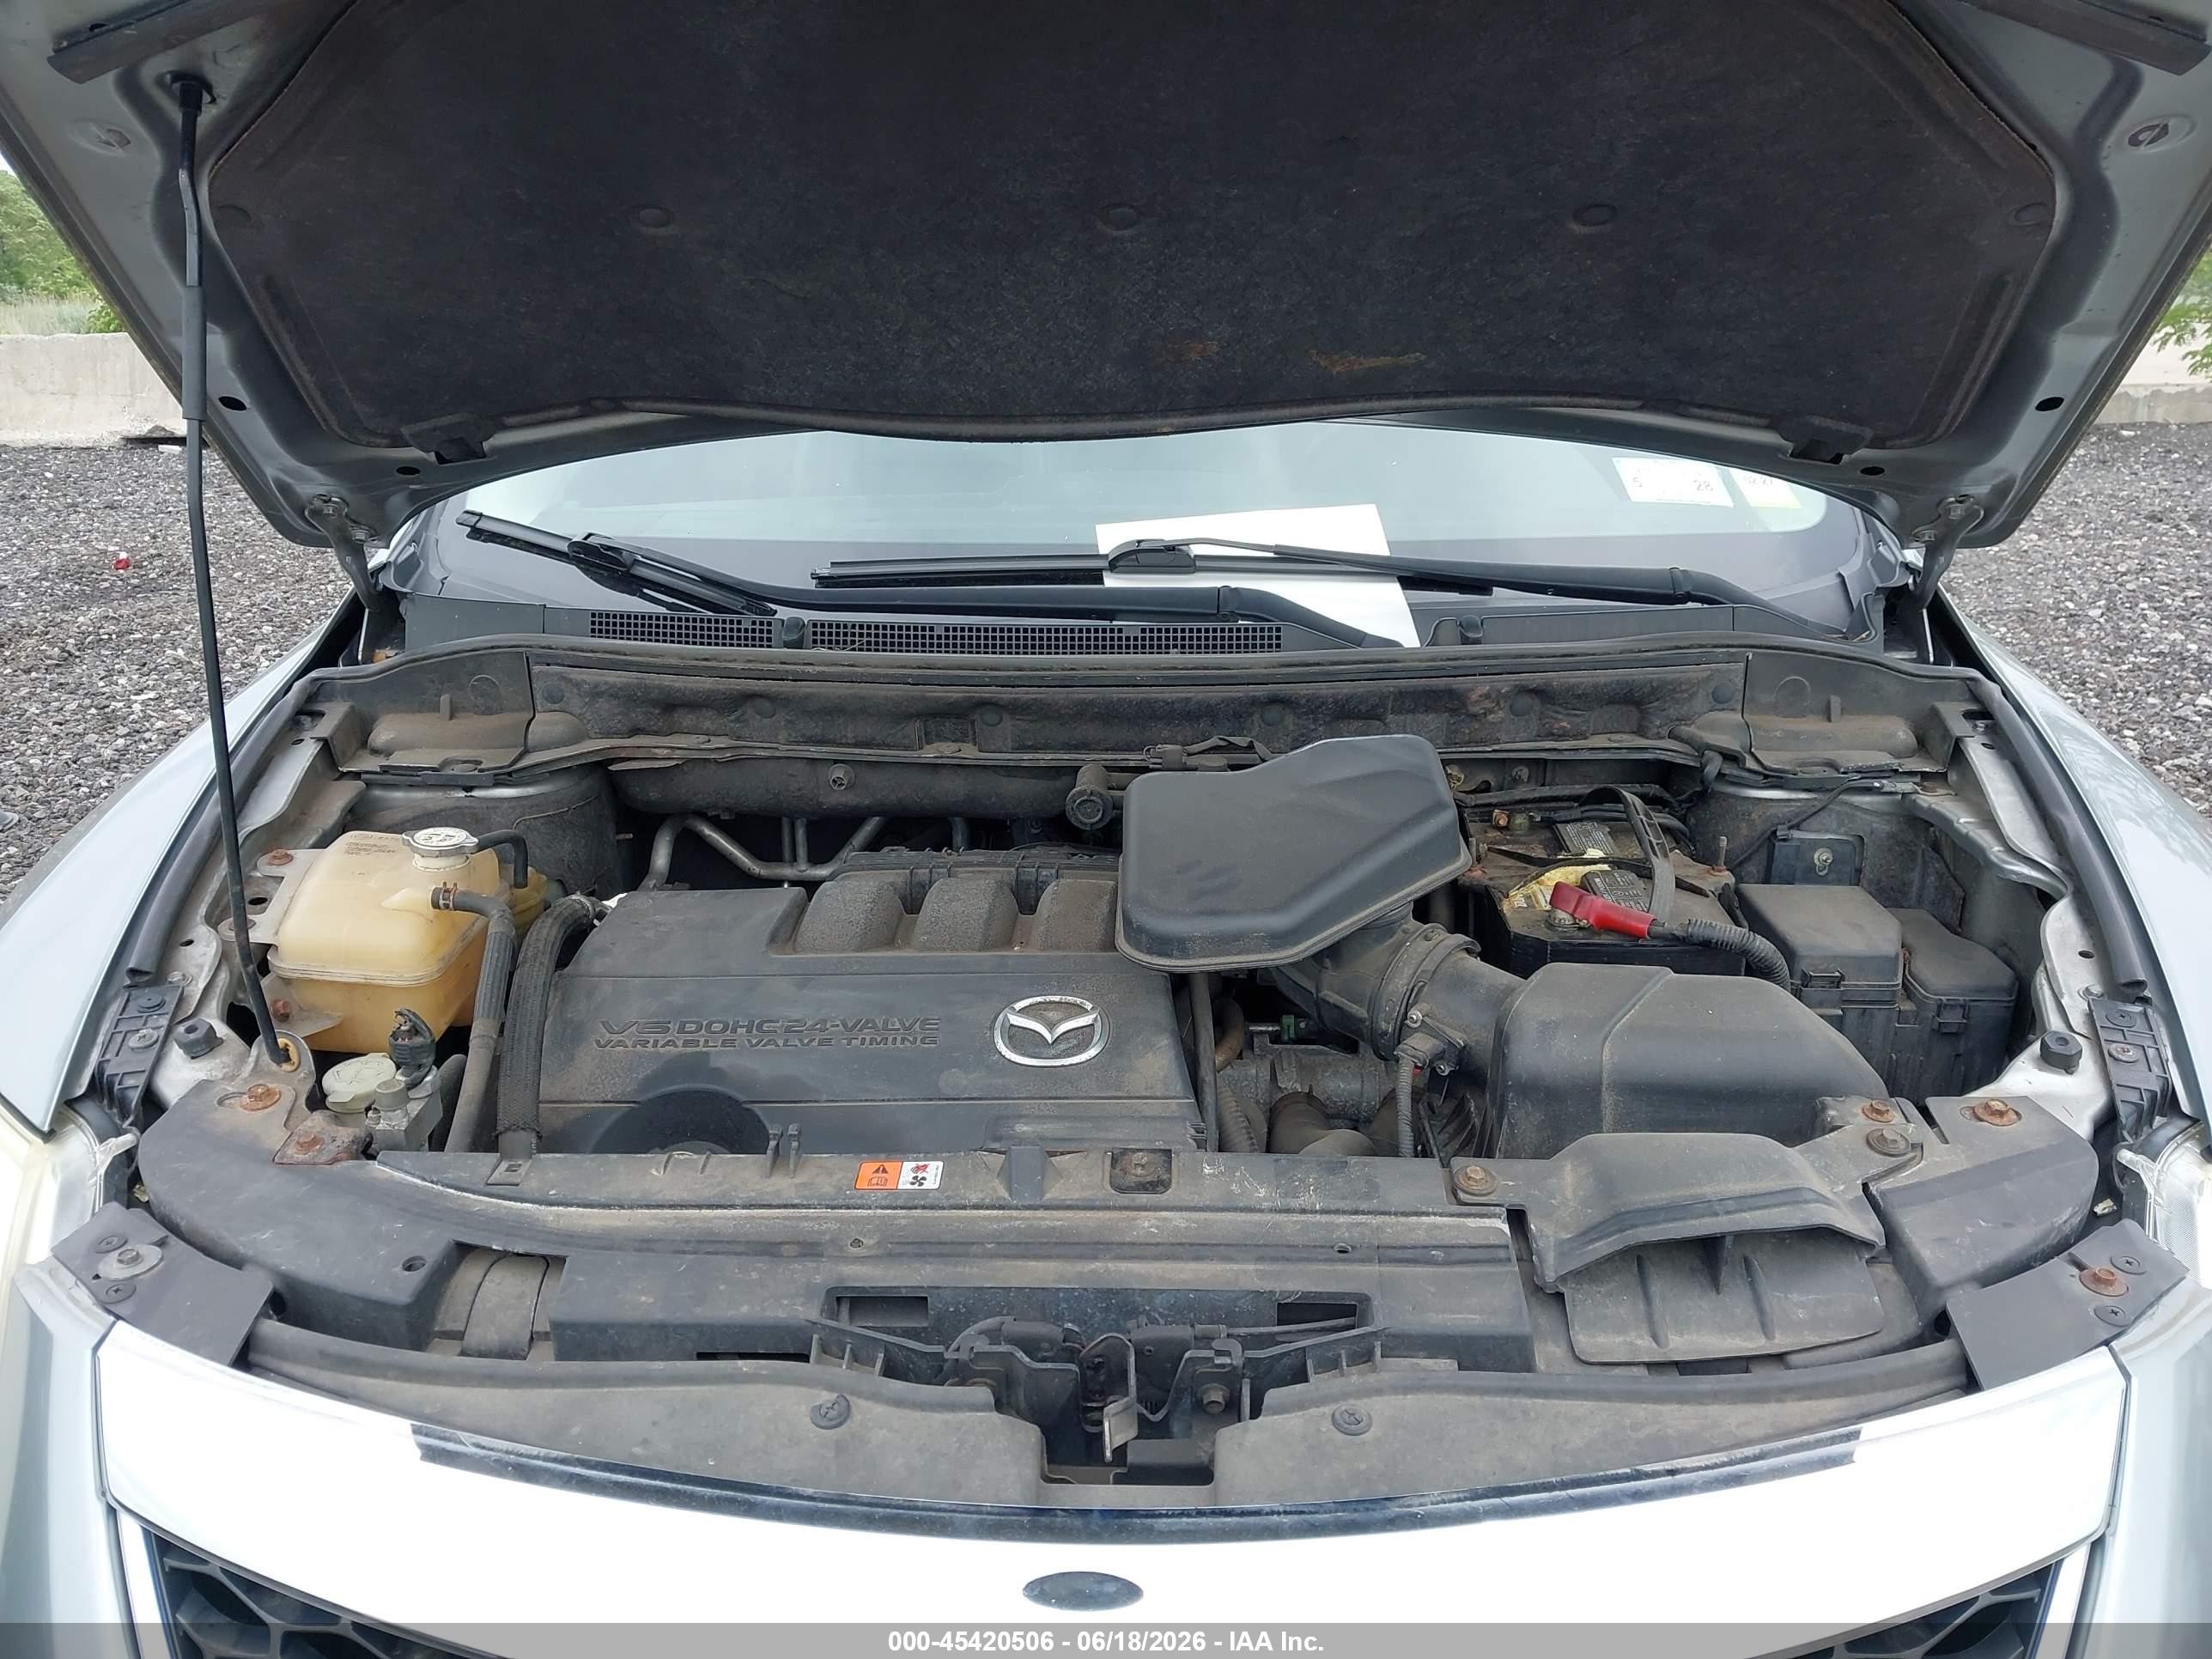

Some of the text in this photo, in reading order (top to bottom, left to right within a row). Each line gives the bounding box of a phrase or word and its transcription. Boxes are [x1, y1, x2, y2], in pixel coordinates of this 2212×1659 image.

[599, 1017, 941, 1035] V6 DOHC 24-VALVE
[594, 1036, 939, 1049] VARIABLE VALVE TIMING
